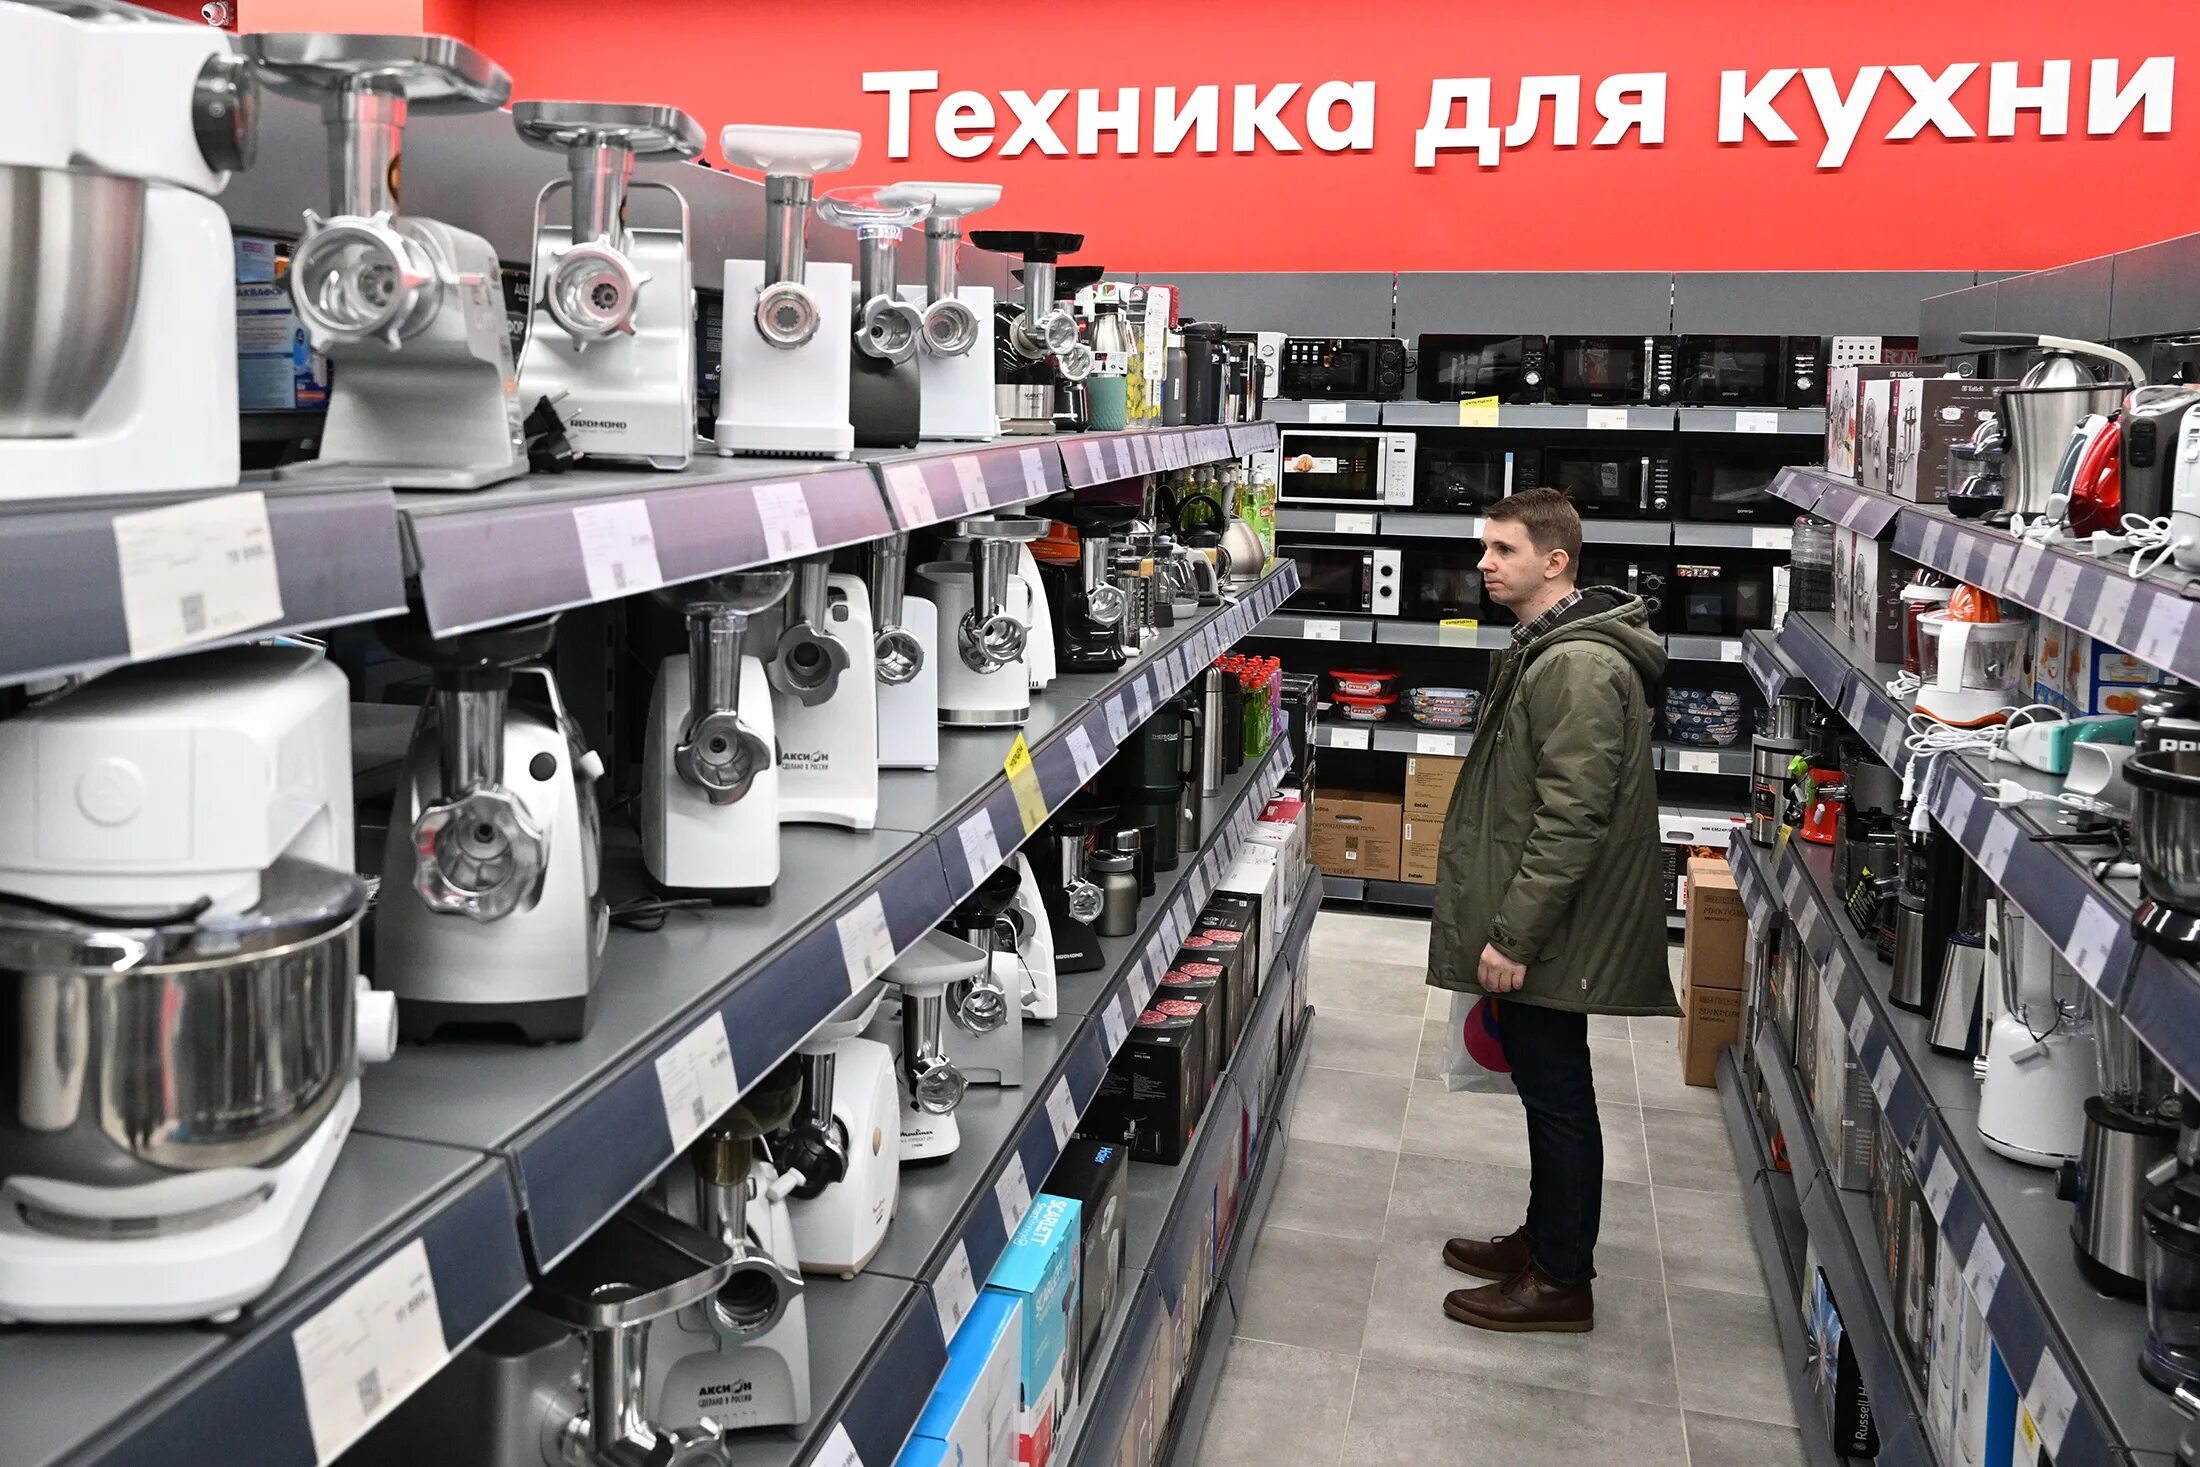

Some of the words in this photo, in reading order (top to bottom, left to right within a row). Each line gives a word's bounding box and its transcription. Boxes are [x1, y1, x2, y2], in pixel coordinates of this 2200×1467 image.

[862, 70, 1376, 159] Техника
[1413, 70, 1667, 169] для
[1718, 56, 2175, 168] кухни
[782, 750, 828, 763] АКСИОН
[1095, 1146, 1112, 1164] Haier
[1031, 1200, 1067, 1248] SCARLETT
[699, 1379, 752, 1396] АКСИОН
[1855, 1397, 1870, 1440] Russell
